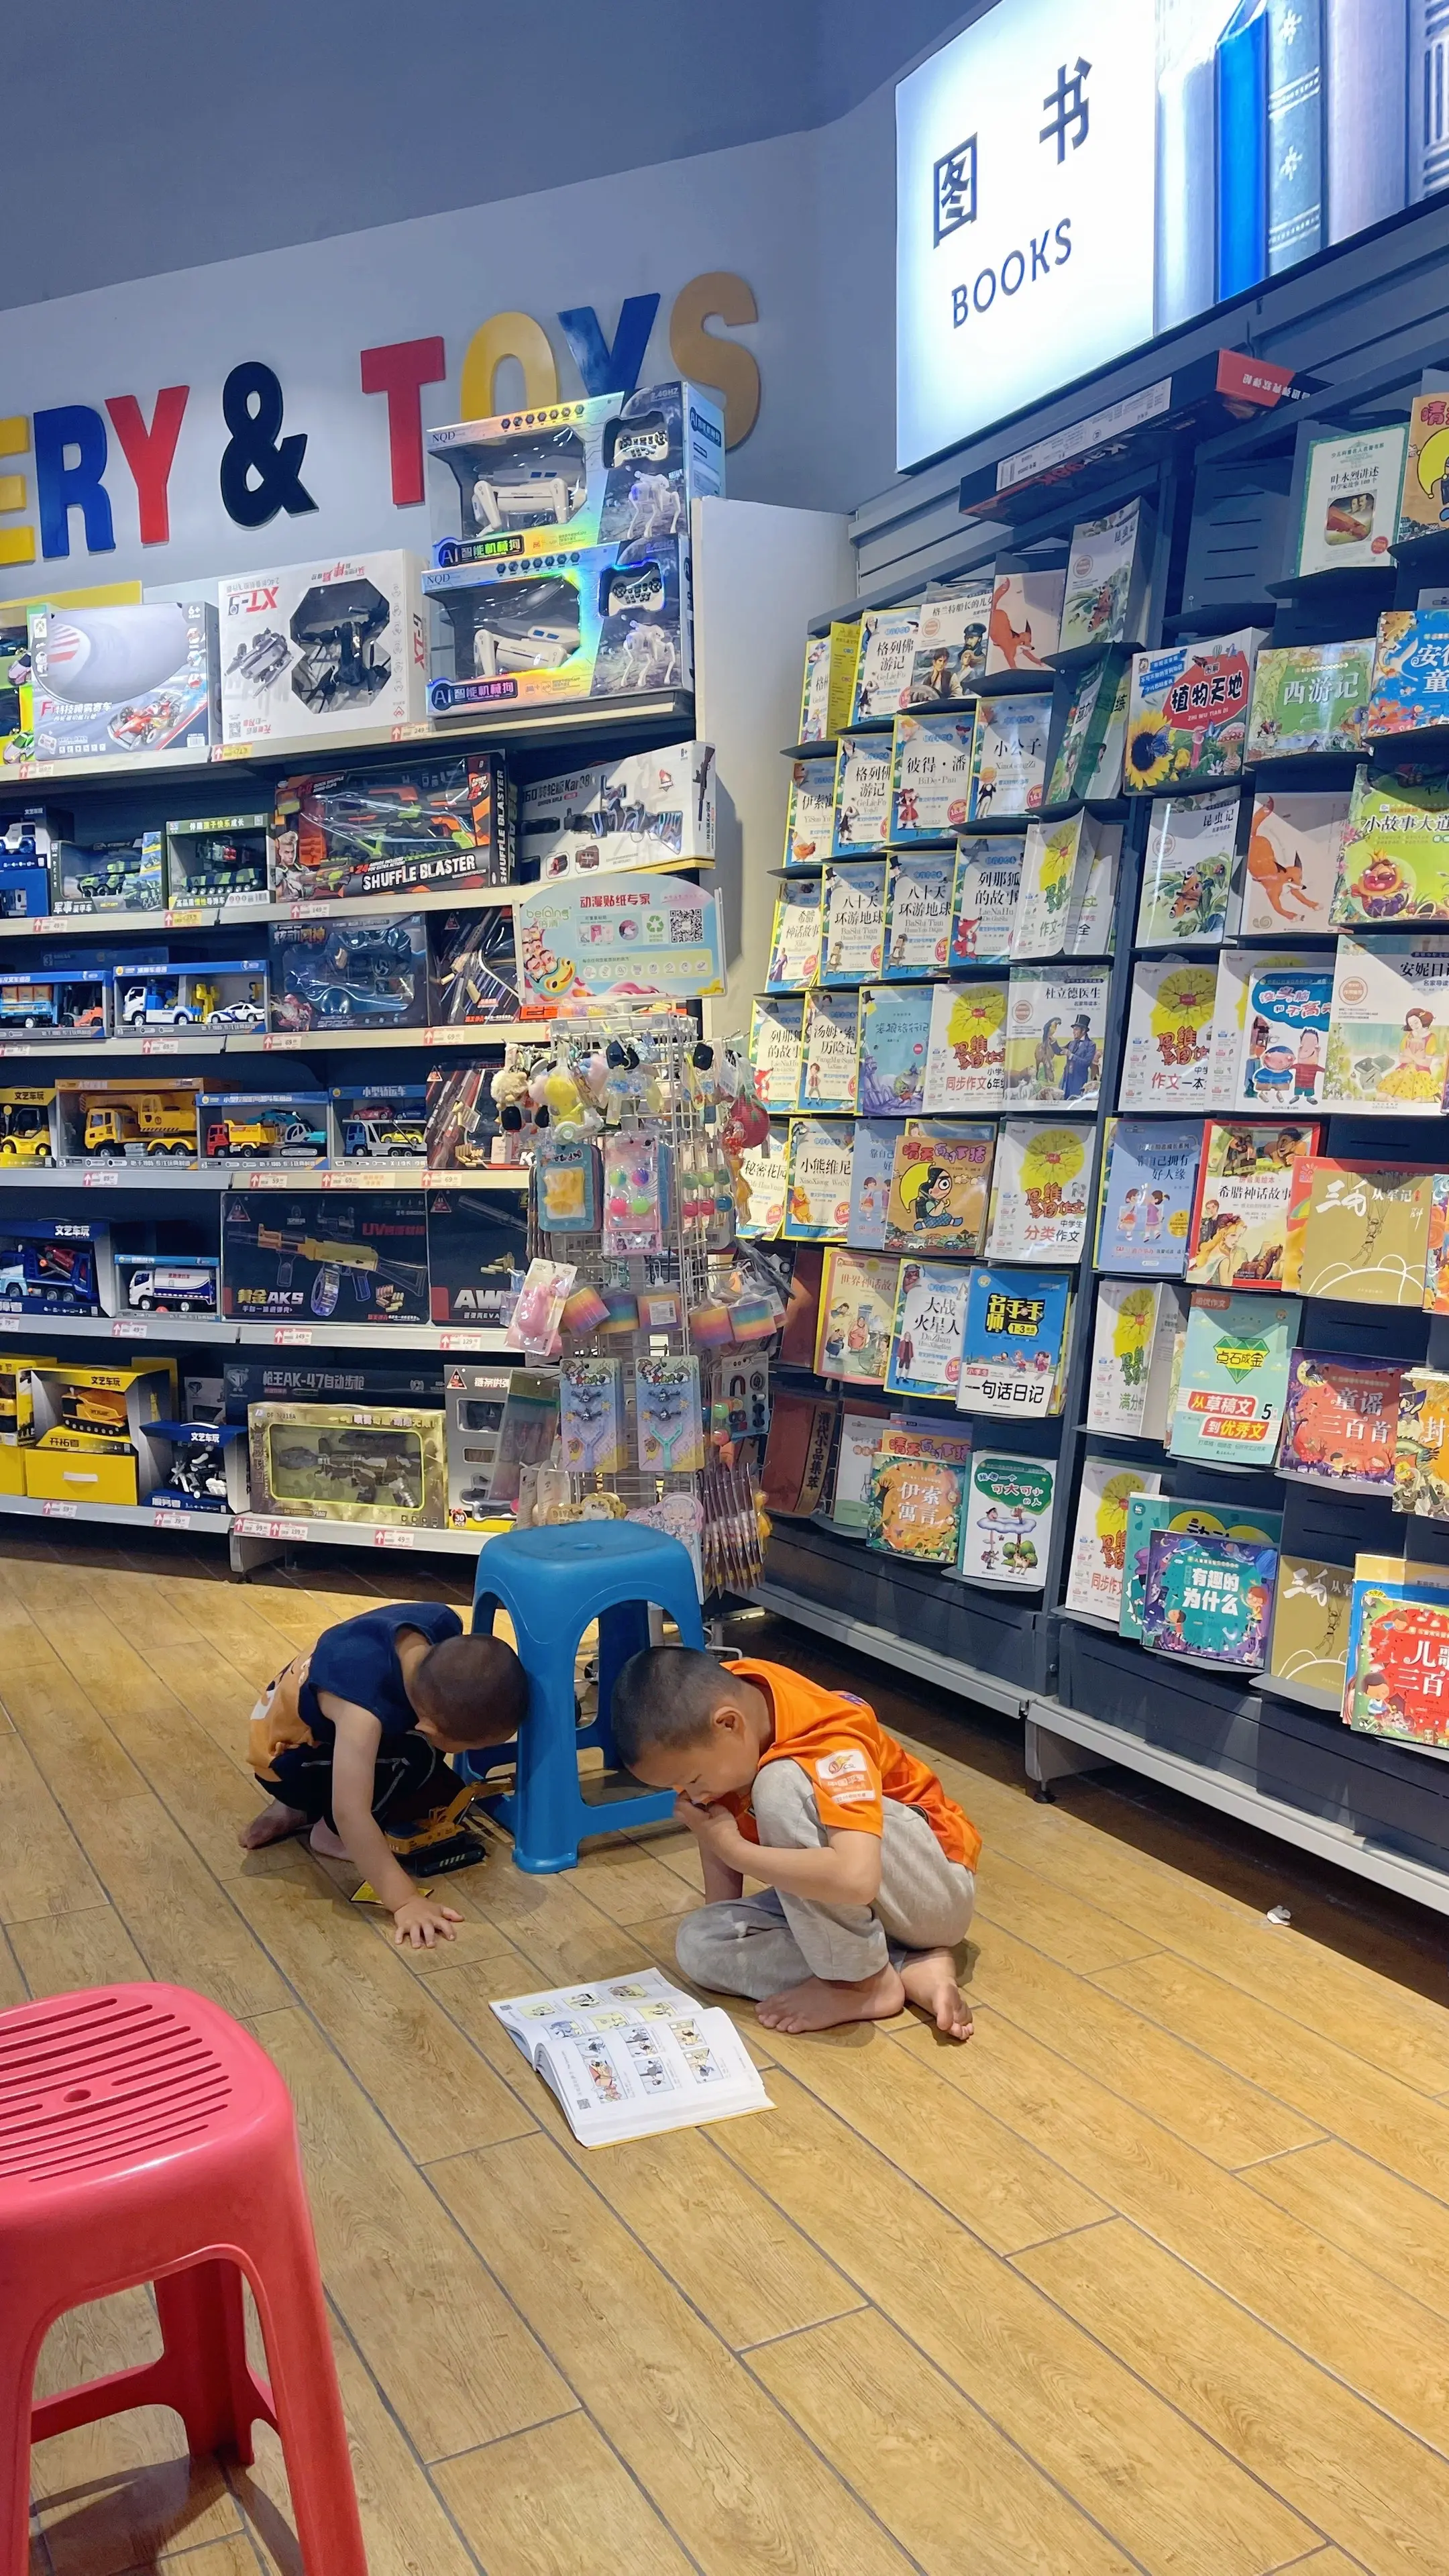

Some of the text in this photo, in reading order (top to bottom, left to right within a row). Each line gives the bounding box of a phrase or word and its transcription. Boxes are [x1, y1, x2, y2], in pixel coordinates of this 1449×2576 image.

[934, 56, 1092, 248] 图书
[951, 219, 1072, 329] BOOKS
[1420, 400, 1449, 427] 晴
[431, 431, 456, 443] NQD
[426, 572, 450, 584] NQD
[877, 638, 914, 657] 格列佛
[880, 655, 905, 672] 游记
[1171, 672, 1244, 714] 植物天地
[1283, 671, 1360, 706] 西游记
[994, 738, 1042, 758] 小公子
[856, 765, 890, 782] 格列佛
[907, 755, 967, 774] 彼得·潘
[498, 770, 506, 826] BLASTER
[860, 782, 885, 797] 游记
[1203, 808, 1235, 827] 昆虫记
[498, 829, 508, 884] SHUFFLE
[355, 863, 370, 874] 24
[362, 865, 417, 892] SHUFFLE
[419, 854, 476, 880] BLASTER
[977, 871, 1020, 888] 列那狐
[580, 893, 651, 908] 动漫贴纸专家
[908, 884, 947, 900] 八十天
[843, 894, 879, 909] 八十天
[899, 902, 951, 917] 环游地球
[835, 910, 884, 925] 环游地球
[1045, 987, 1101, 1000] 杜立德医生
[1259, 986, 1310, 1004] 没头脑
[820, 1041, 857, 1056] 历险记
[946, 1076, 987, 1091] 同步作文
[1151, 1071, 1208, 1091] 作文一本
[800, 1159, 851, 1175] 小熊维尼
[1152, 1168, 1185, 1181] 好人缘
[1219, 1185, 1291, 1201] 希腊神话故事
[55, 1224, 91, 1237] 文艺车玩
[1024, 1224, 1081, 1242] 分类作文
[1060, 1220, 1083, 1228] 中学生
[841, 1273, 896, 1291] 世界神话故
[237, 1287, 304, 1305] 黄金AKS
[924, 1297, 957, 1317] 大战
[913, 1315, 961, 1336] 火星人
[1216, 1349, 1265, 1368] 点石成金
[91, 1376, 121, 1386] 文艺车玩
[965, 1379, 1045, 1404] 一句话日记
[1193, 1395, 1254, 1416] 从草稿文
[1331, 1387, 1384, 1417] 童谣
[1260, 1403, 1273, 1420] 5
[191, 1432, 220, 1442] 文艺车玩
[1206, 1420, 1267, 1440] 到优秀文
[1318, 1413, 1393, 1444] 三百首
[899, 1481, 942, 1505] 伊索
[991, 1483, 1044, 1496] 可大可小
[1023, 1496, 1042, 1507] 的人
[455, 1514, 466, 1522] 30
[898, 1501, 939, 1526] 寓言
[1191, 1567, 1240, 1592] 有趣的
[1182, 1586, 1239, 1617] 为什么
